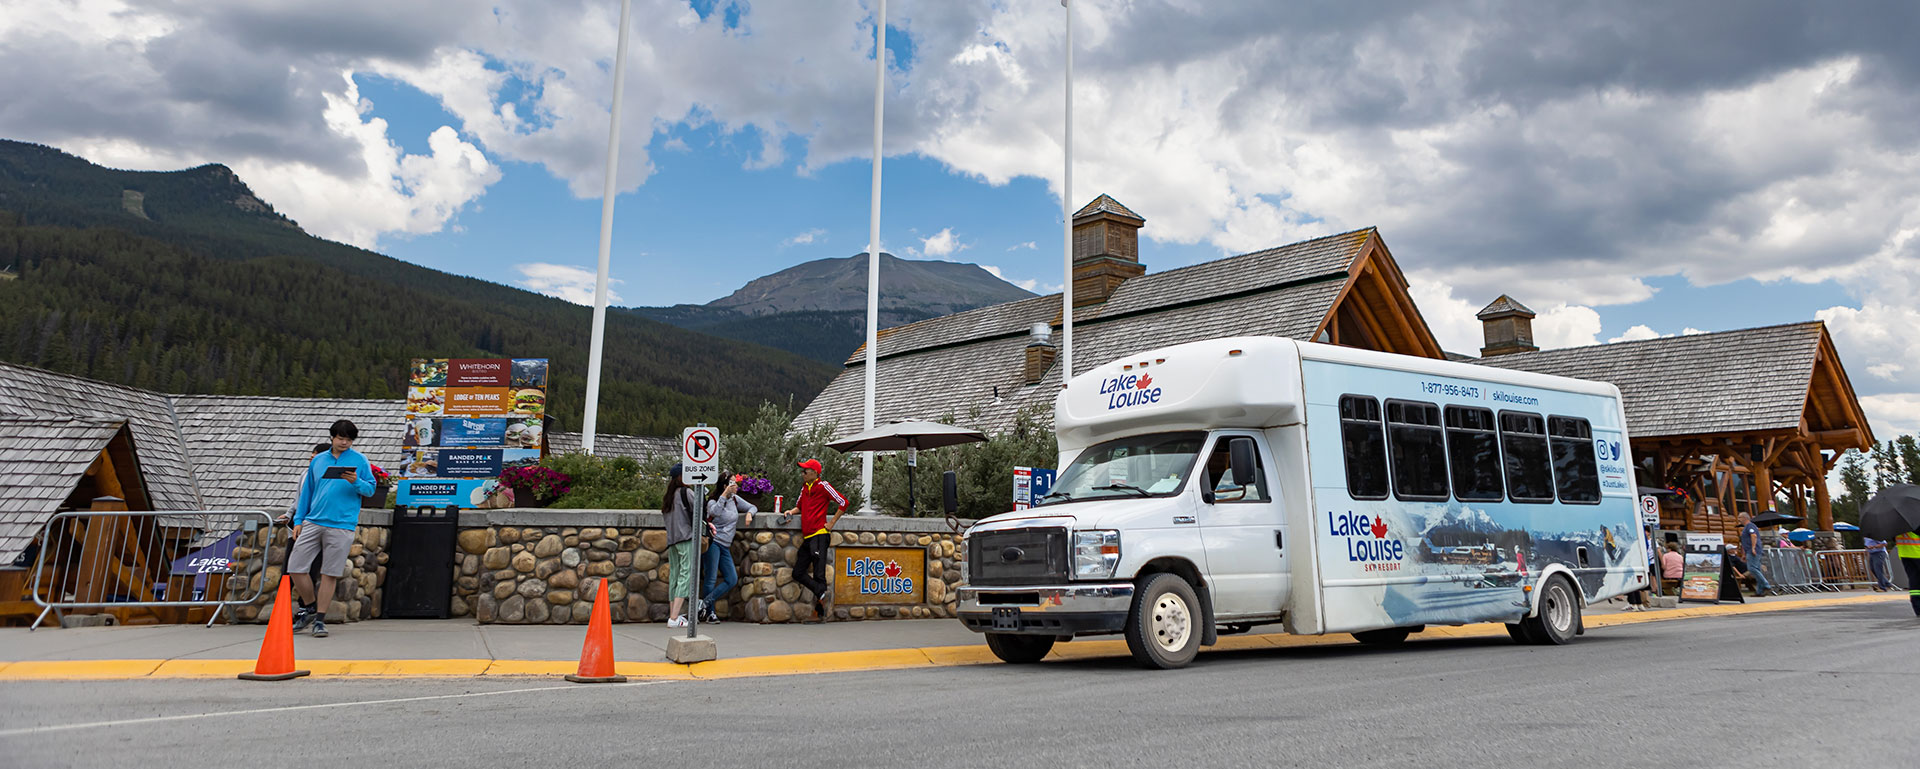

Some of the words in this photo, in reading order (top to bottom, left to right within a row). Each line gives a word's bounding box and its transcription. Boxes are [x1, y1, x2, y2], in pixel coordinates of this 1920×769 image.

[1099, 374, 1137, 395] Lake
[1421, 381, 1479, 399] 1-877-956-8473
[1492, 390, 1539, 406] skilouise.com
[1108, 387, 1162, 410] Louise
[1328, 510, 1371, 536] Lake
[1347, 537, 1403, 561] Louise
[188, 556, 230, 567] Lake
[846, 557, 885, 576] Lake
[1378, 563, 1401, 572] RESORT
[860, 575, 913, 594] Louise
